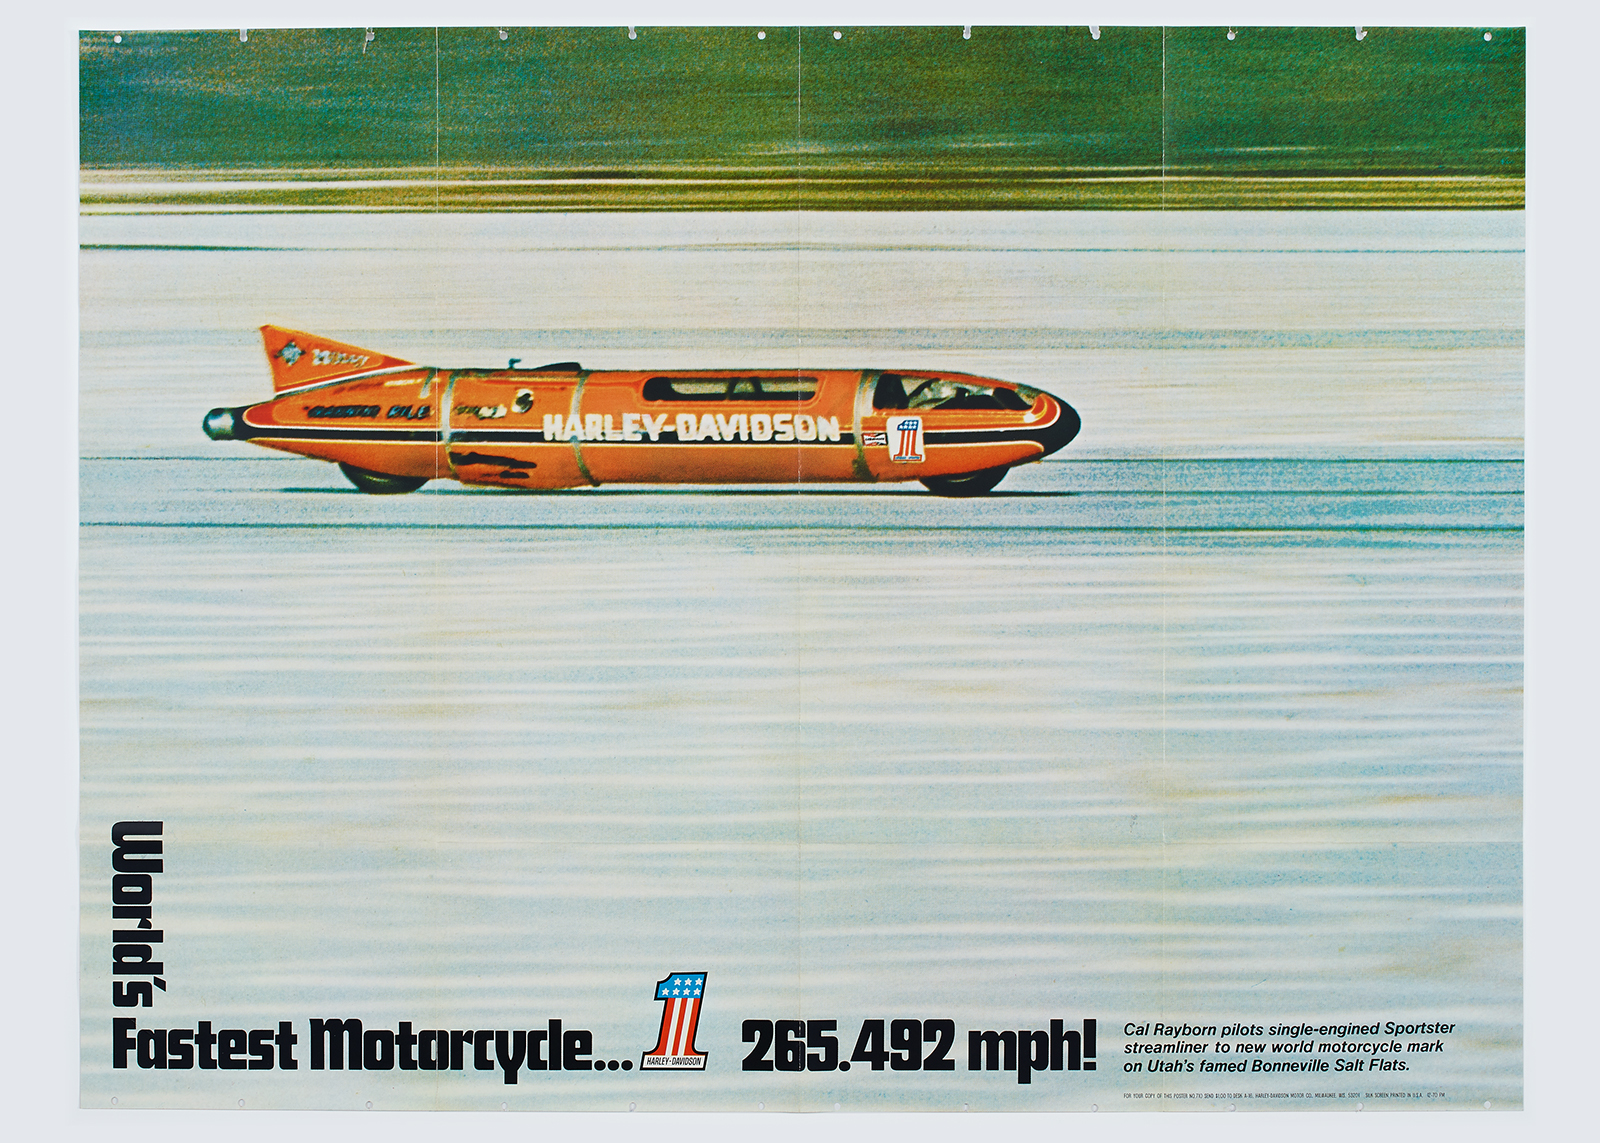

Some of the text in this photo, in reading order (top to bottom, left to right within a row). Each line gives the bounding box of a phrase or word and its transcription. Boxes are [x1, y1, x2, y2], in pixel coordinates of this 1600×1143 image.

[542, 412, 841, 443] HARLEY-DAVIDSON
[111, 820, 167, 1008] World's
[1123, 1021, 1456, 1040] Cal Rayborn pilots single-engined Sportster
[112, 1017, 634, 1085] Fastest Motorcycle...
[741, 1018, 1097, 1085] 265.492 mph!
[1123, 1039, 1445, 1057] streamliner to new world motorcycle mark
[646, 1057, 703, 1067] HARLEY-DAVIDSON
[1123, 1058, 1411, 1073] on Utah's famed Bonneville Salt Flats.
